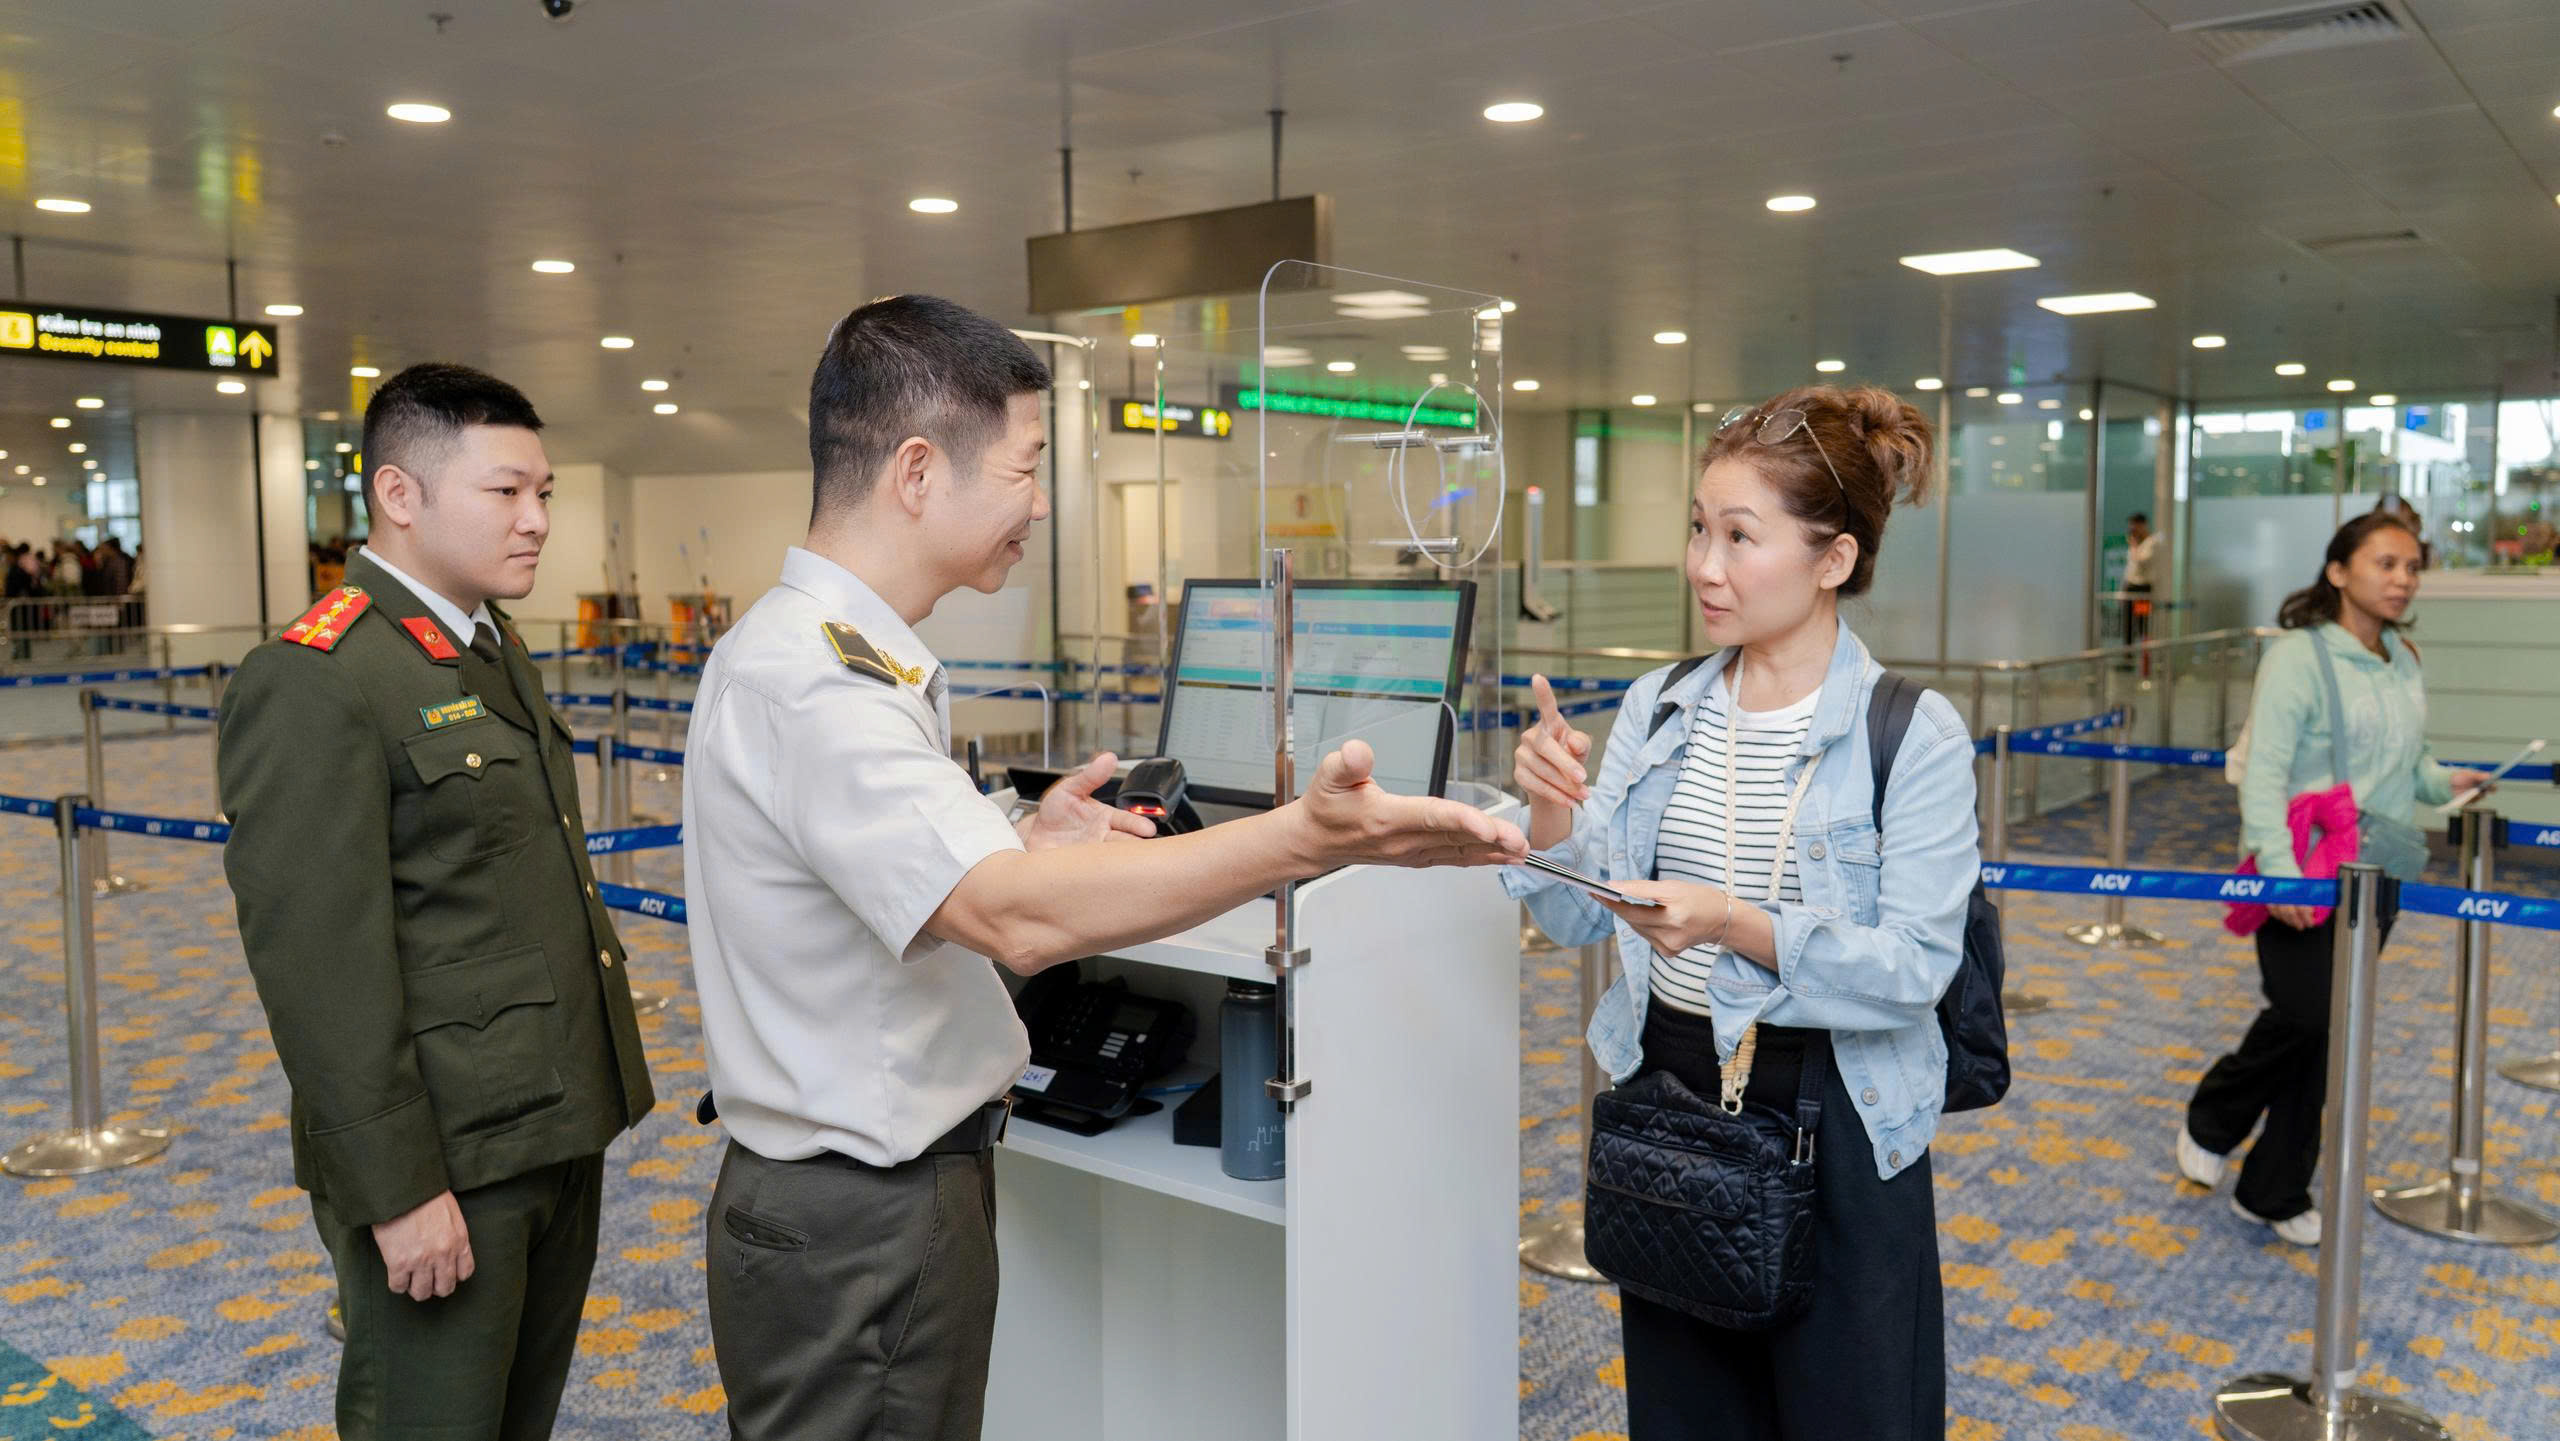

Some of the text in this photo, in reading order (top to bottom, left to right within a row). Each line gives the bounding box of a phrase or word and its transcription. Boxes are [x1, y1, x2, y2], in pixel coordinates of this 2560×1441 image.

[38, 332, 160, 359] Security control
[211, 330, 233, 353] A
[586, 835, 615, 852] ACV
[2536, 829, 2560, 845] AC
[1981, 867, 2265, 897] CV ACV ACV
[640, 897, 666, 915] ACV
[2457, 896, 2510, 918] ACV
